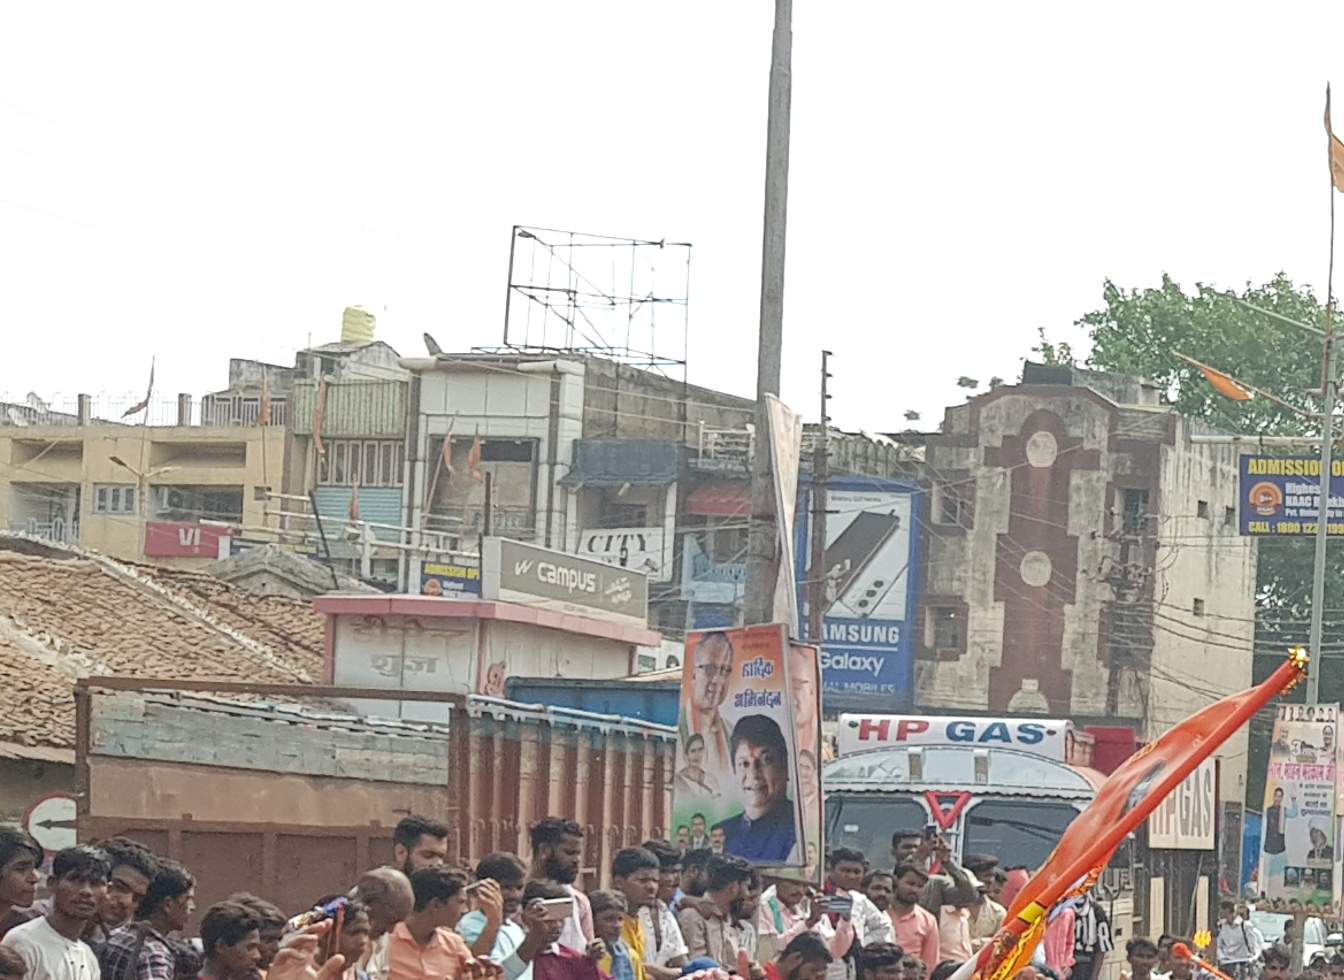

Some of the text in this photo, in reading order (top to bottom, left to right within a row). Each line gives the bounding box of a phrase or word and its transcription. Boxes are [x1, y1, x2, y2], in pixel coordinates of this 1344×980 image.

[1248, 459, 1321, 477] ADMISSIO
[1285, 482, 1320, 495] Highes
[537, 561, 596, 593] campus
[820, 652, 884, 677] Galaxy
[858, 719, 1045, 745] HP GAS
[1179, 767, 1212, 838] GAS
